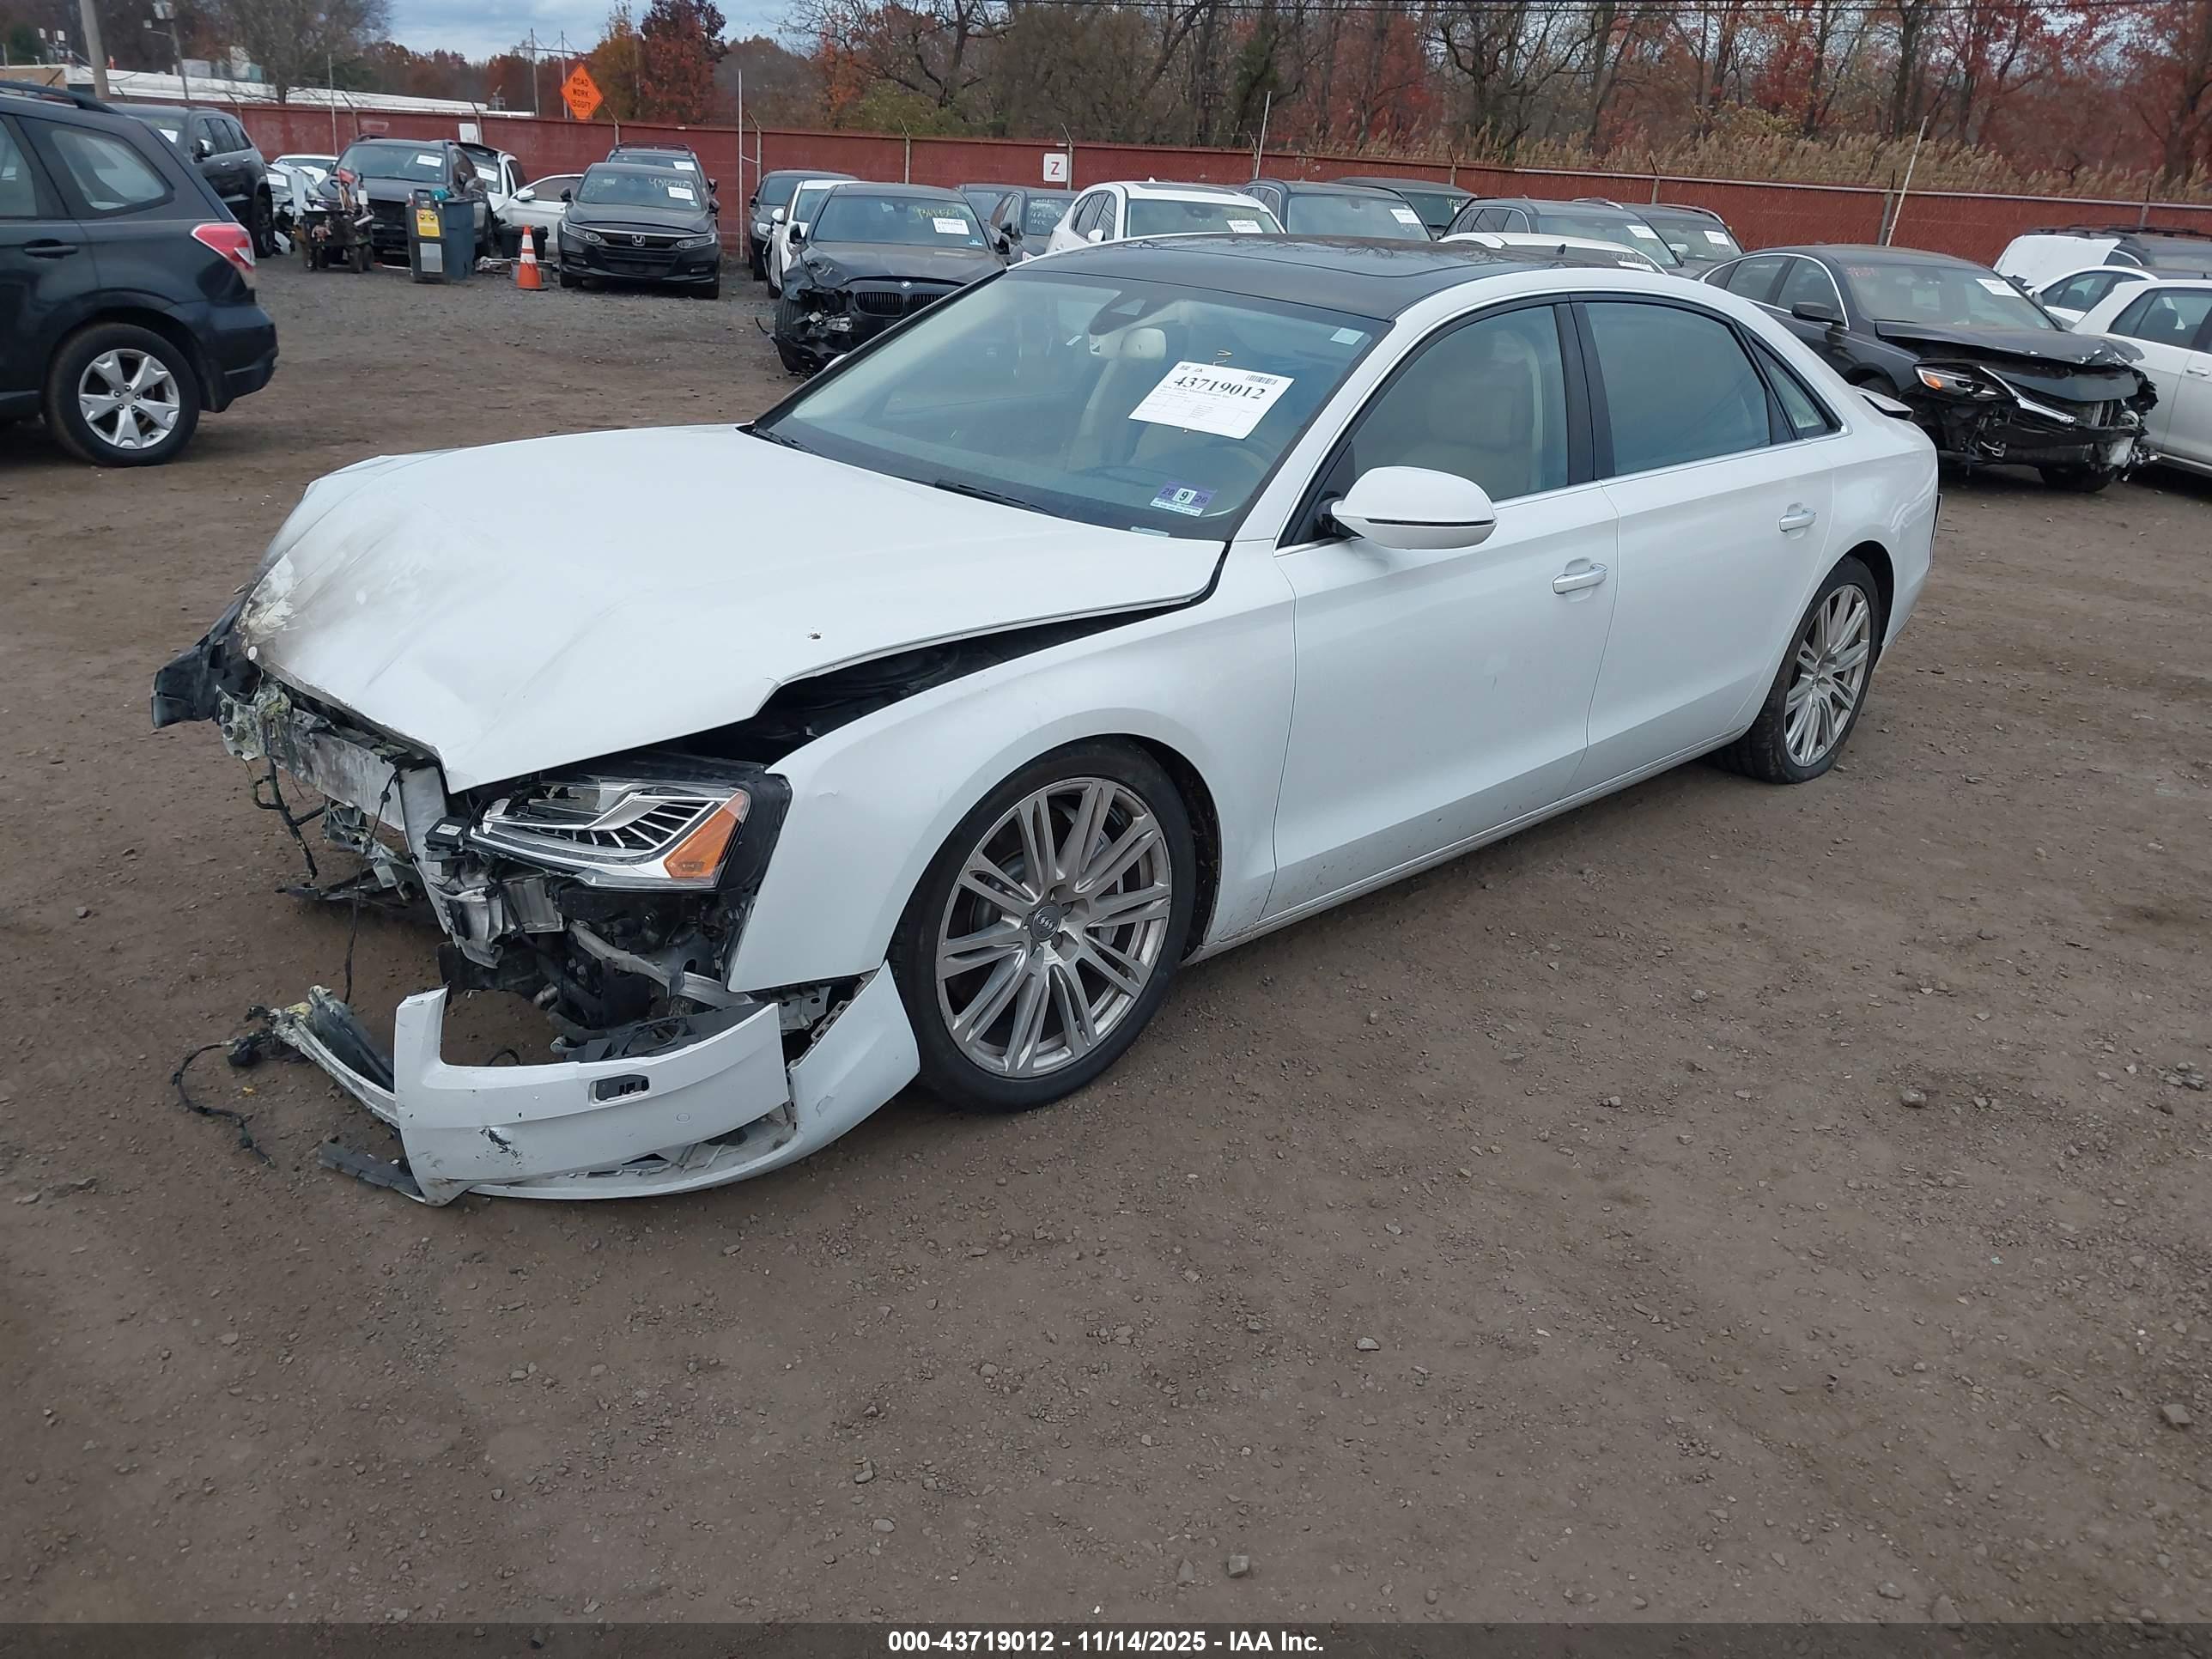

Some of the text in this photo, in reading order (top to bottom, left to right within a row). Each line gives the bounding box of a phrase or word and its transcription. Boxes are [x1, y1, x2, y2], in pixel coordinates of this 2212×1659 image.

[573, 76, 588, 87] ROAD
[573, 88, 589, 97] WORK
[1050, 161, 1060, 175] Z
[1174, 376, 1267, 400] 43719012
[1162, 488, 1176, 496] 20
[1179, 491, 1189, 501] 9
